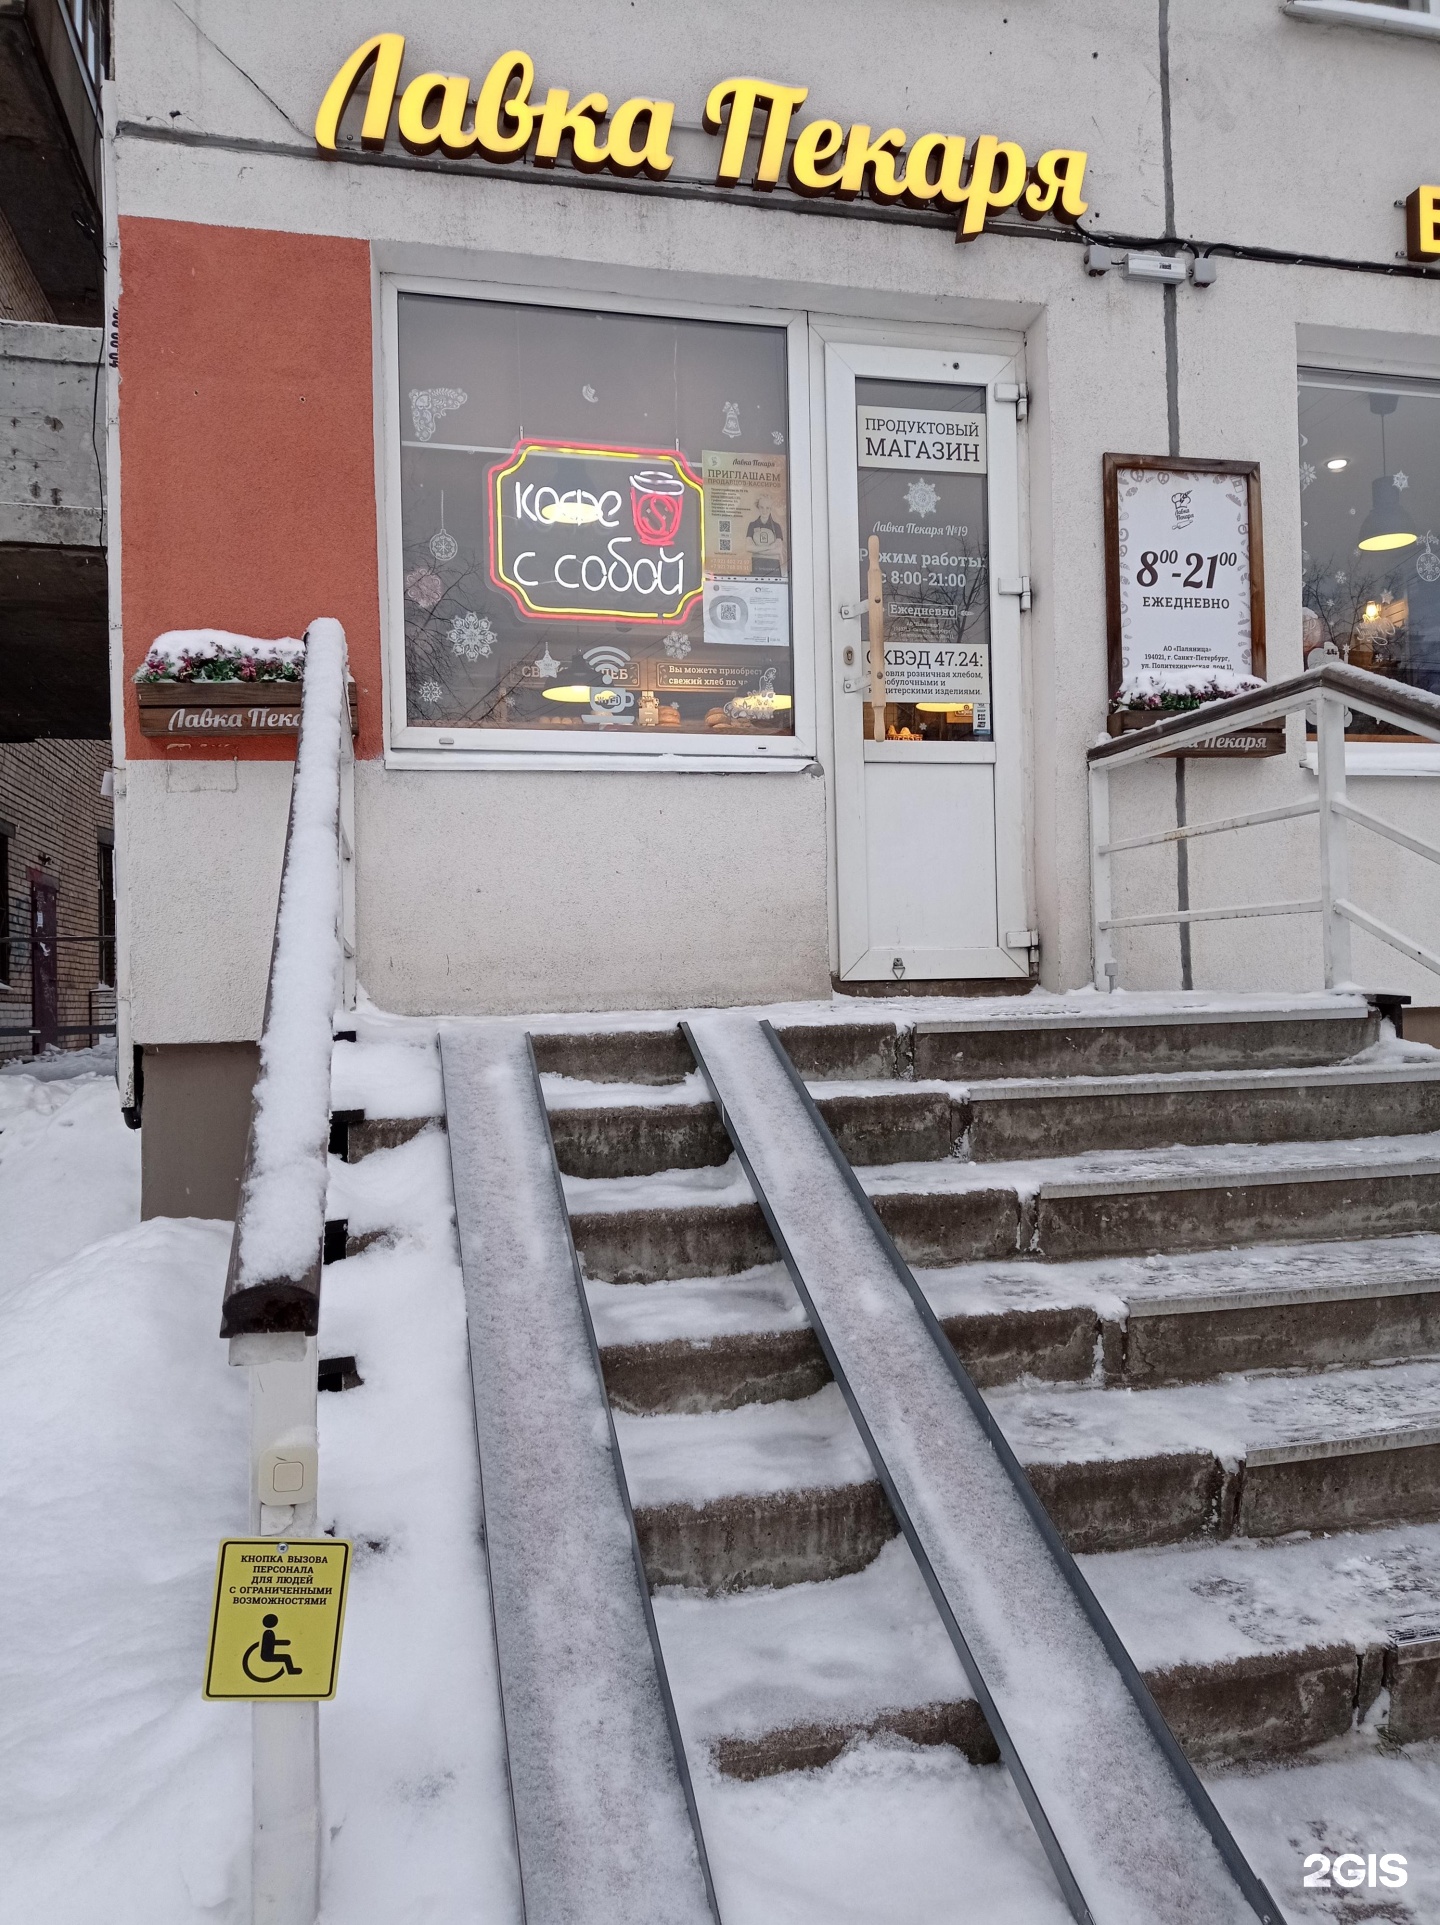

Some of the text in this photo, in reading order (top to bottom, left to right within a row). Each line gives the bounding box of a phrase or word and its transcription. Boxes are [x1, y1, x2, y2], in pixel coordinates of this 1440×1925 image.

[315, 33, 1089, 241] Лавка Пекаря
[865, 417, 980, 437] ПРОДУКТОВЫЙ
[865, 437, 980, 463] МАГАЗИН
[708, 469, 781, 482] ПРИГЛАШАЕМ
[872, 520, 968, 538] Лавка Пекаря №19
[859, 548, 917, 565] Ржим
[554, 537, 684, 595] собой
[890, 571, 967, 588] 8:00-21:00
[1142, 596, 1230, 610] ЕЖЕДНЕВНО
[890, 604, 956, 617] Ежедневно
[934, 651, 983, 667] 47.24:
[668, 665, 682, 673] Вы
[906, 671, 951, 679] розничная
[952, 671, 983, 679] хлебом,
[668, 677, 703, 685] свежий
[704, 677, 724, 686] хлеб
[168, 707, 300, 731] Лавка Пек
[240, 1555, 328, 1564] КНОПКА ВЫЗОВА
[253, 1565, 314, 1574] ПЕРСОНАЛА
[251, 1574, 314, 1585] ДЛЯ ЛЮДЕЙ
[229, 1586, 333, 1595] С ОГРАНИЧЕННЫМИ
[232, 1597, 327, 1606] ВОЗМОЖНОСТЯМИ
